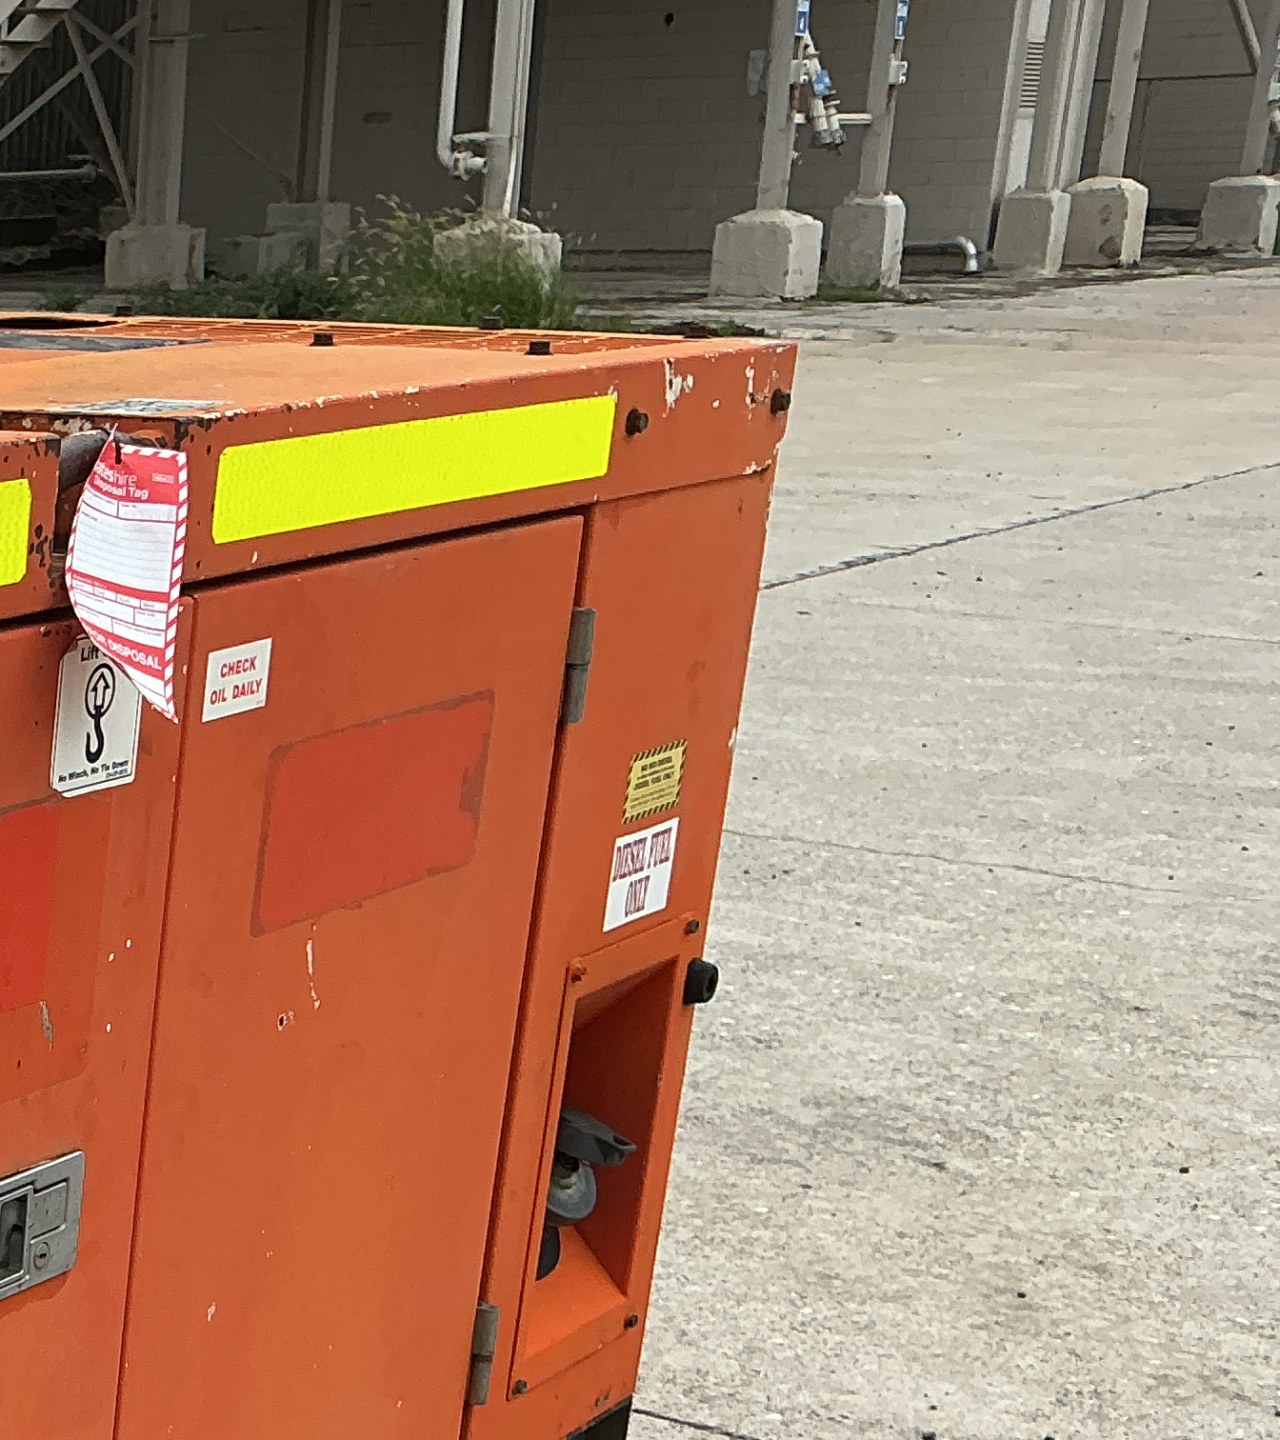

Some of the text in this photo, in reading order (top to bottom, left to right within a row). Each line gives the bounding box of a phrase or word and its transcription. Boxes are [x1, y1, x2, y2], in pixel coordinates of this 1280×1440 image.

[93, 474, 126, 497] Disposal
[128, 487, 149, 500] Tag
[107, 639, 162, 671] DISPOSAL
[220, 655, 257, 678] CHECK
[210, 678, 263, 705] OIL DAILY
[612, 826, 673, 882] DIESEL FUEL
[624, 875, 651, 917] ONLY
